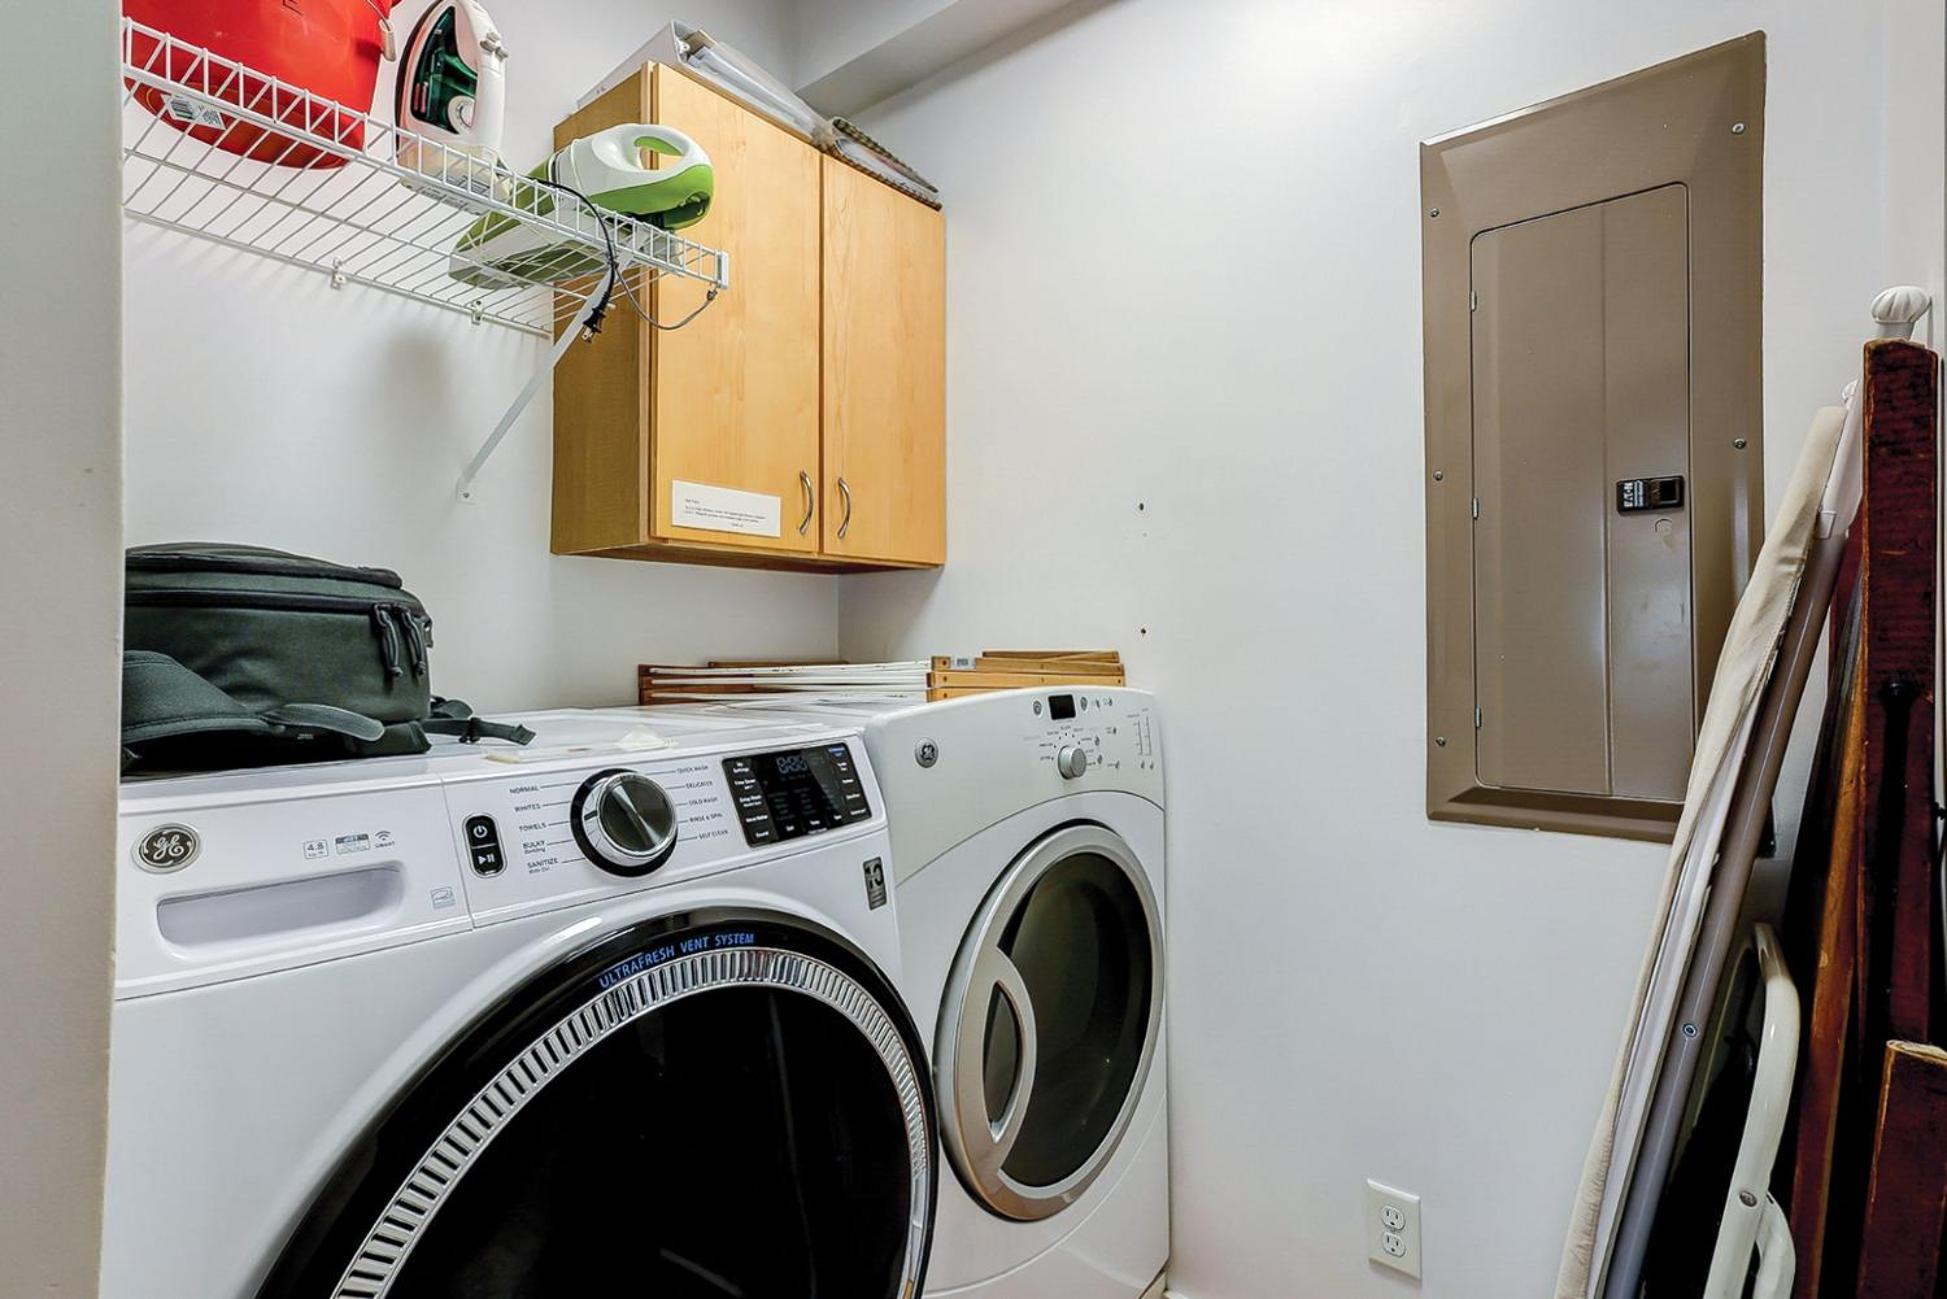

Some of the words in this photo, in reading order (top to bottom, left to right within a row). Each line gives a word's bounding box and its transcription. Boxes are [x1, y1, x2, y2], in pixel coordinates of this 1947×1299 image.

[509, 785, 540, 794] NORMAL
[513, 803, 541, 812] WHITES
[518, 822, 547, 832] TOWELS
[522, 840, 545, 849] BULKY
[527, 857, 559, 868] SANITIZE
[598, 945, 675, 988] ULTRAFRESH
[679, 936, 710, 953] VENT
[714, 932, 755, 947] SYSTEM
